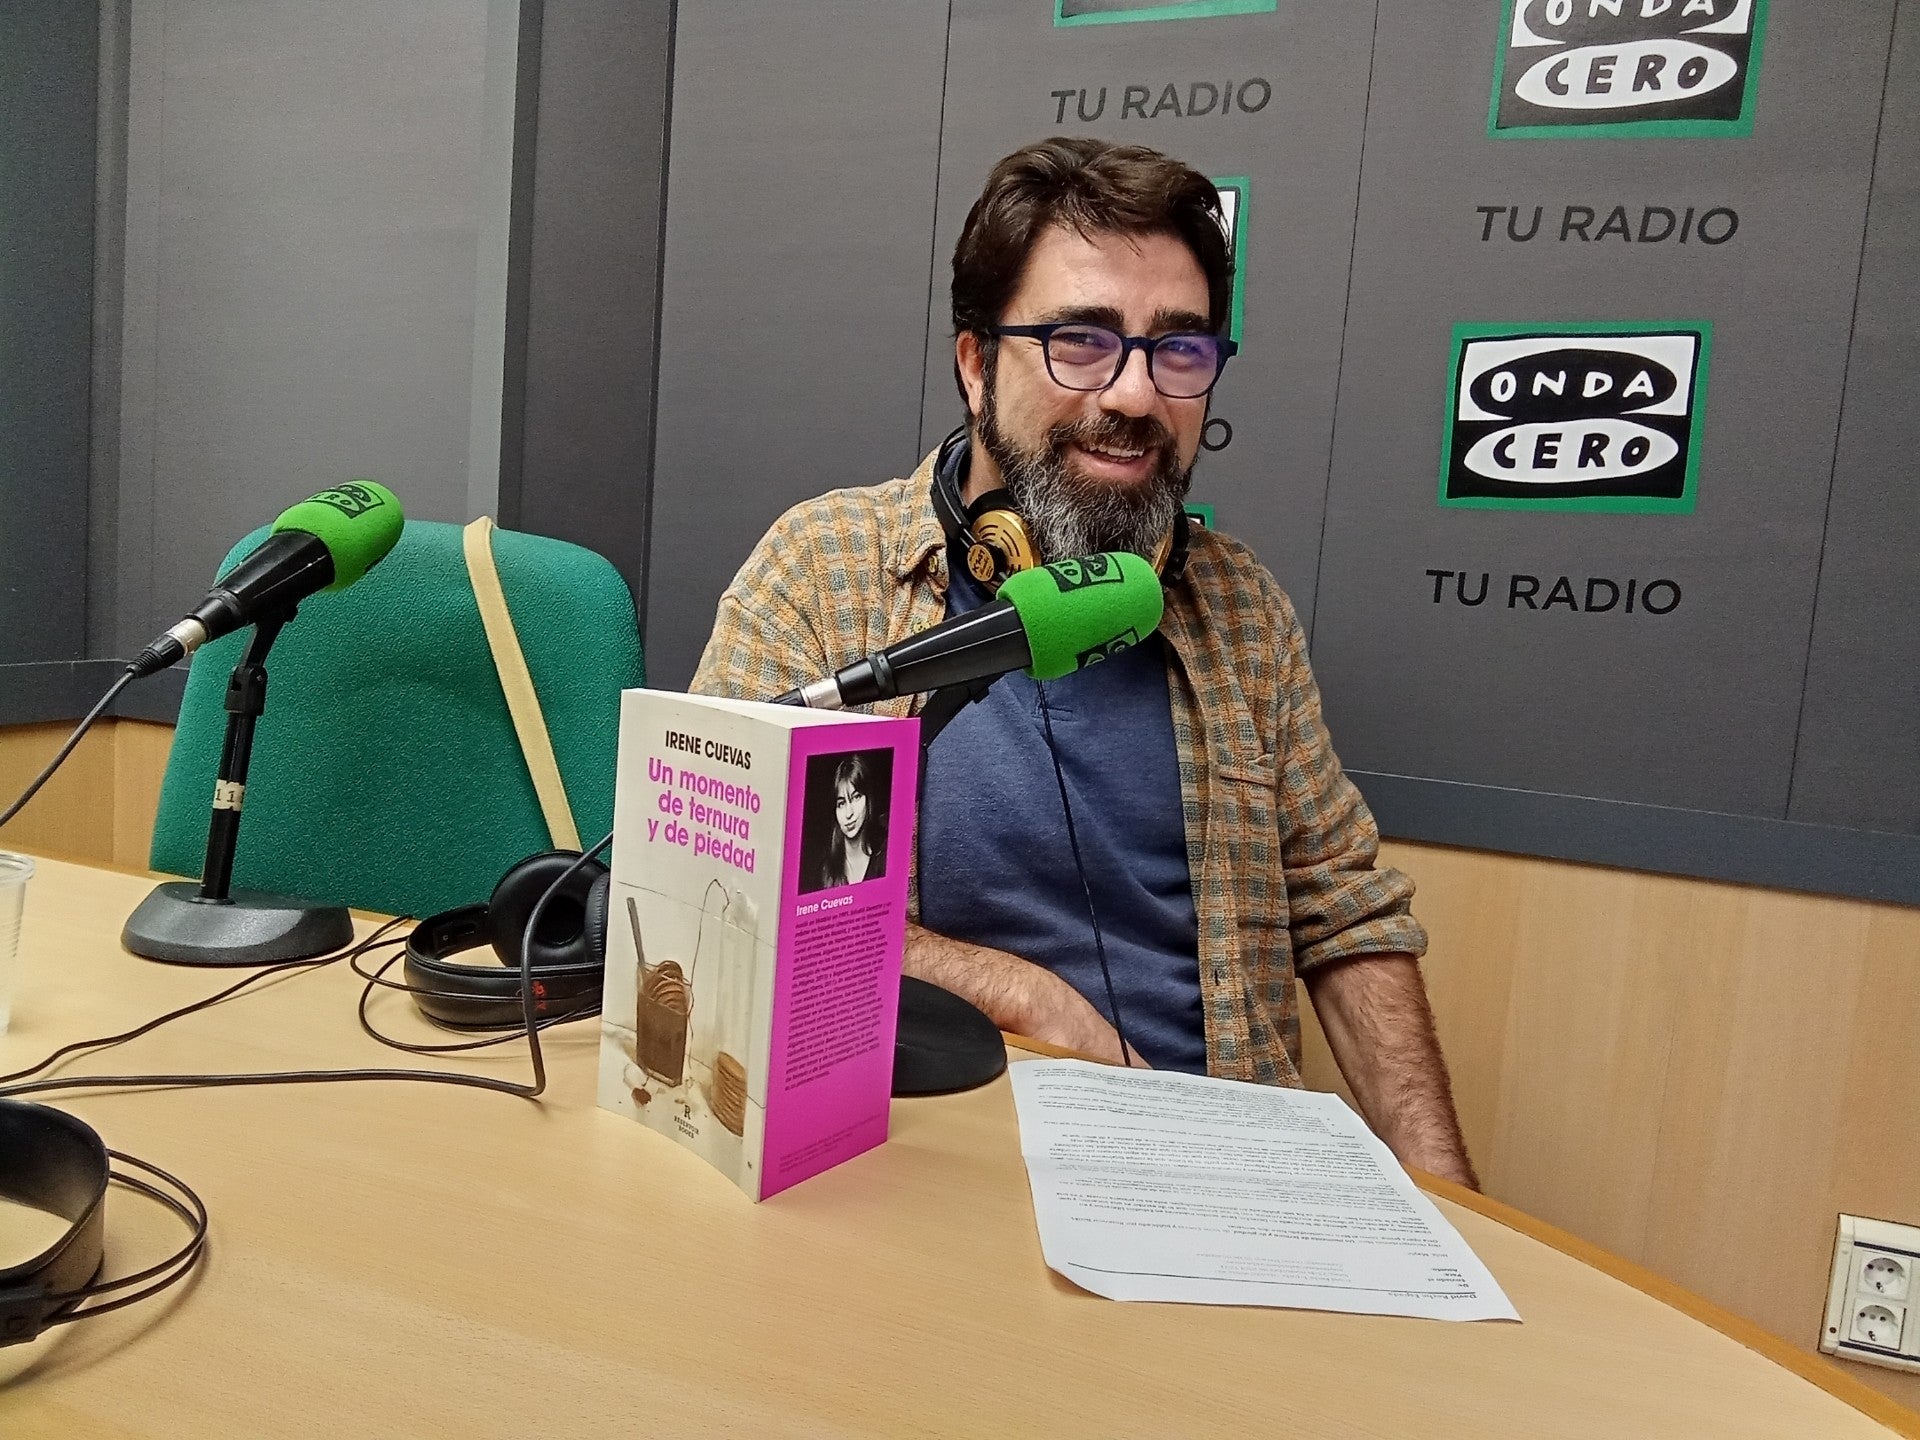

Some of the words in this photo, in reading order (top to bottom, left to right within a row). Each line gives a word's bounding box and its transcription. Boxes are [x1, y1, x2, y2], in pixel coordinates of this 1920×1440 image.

[1545, 54, 1709, 96] CERO
[1051, 88, 1107, 124] TU
[1121, 77, 1272, 120] RADIO
[1476, 206, 1543, 242] TU
[1559, 205, 1739, 245] RADIO
[1490, 370, 1655, 402] ONDA
[1493, 432, 1651, 469] CERO
[1426, 569, 1489, 606] TU
[1507, 574, 1682, 614] RADIO
[665, 730, 702, 755] IRENE
[704, 740, 752, 770] CUEVAS
[648, 757, 673, 785] Un
[679, 768, 761, 814] momento
[658, 790, 683, 816] de
[689, 797, 750, 840] ternura
[647, 818, 659, 842] y
[664, 822, 689, 847] de
[694, 831, 755, 874] piedad
[796, 902, 818, 917] Irene
[821, 895, 854, 910] Cuevas
[684, 1104, 691, 1120] R
